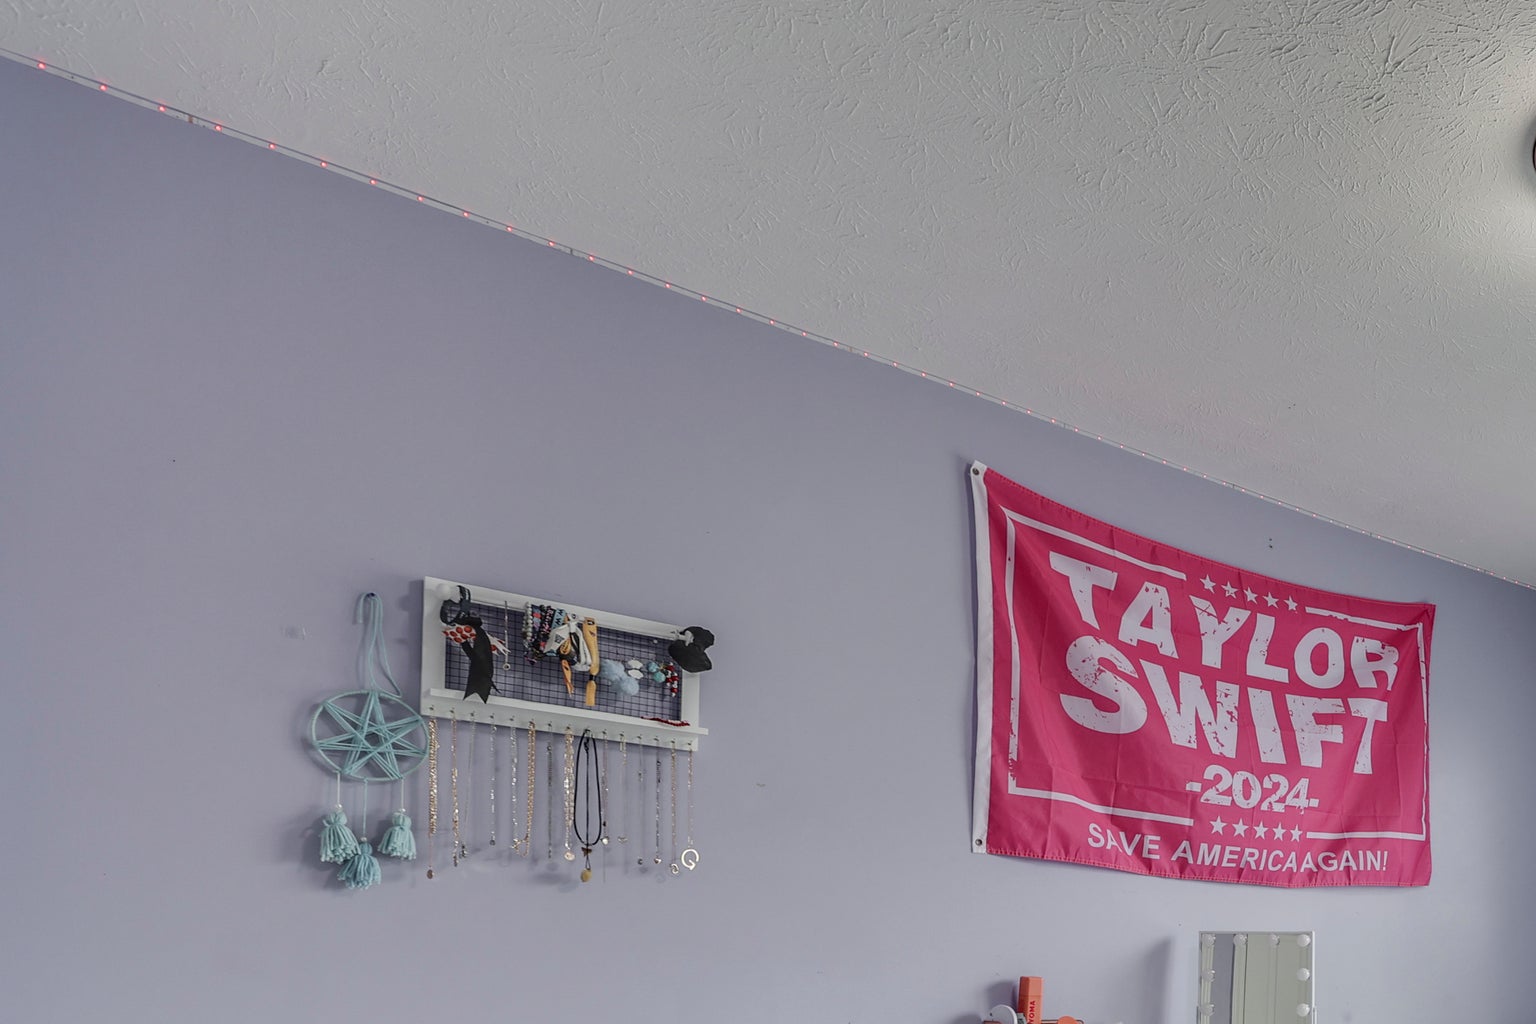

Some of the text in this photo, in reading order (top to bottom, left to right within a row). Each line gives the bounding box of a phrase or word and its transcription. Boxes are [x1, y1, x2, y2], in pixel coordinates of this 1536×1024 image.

[1049, 551, 1400, 691] TAYLOR
[1060, 635, 1388, 775] SWIFT
[1087, 823, 1161, 860] SAVE
